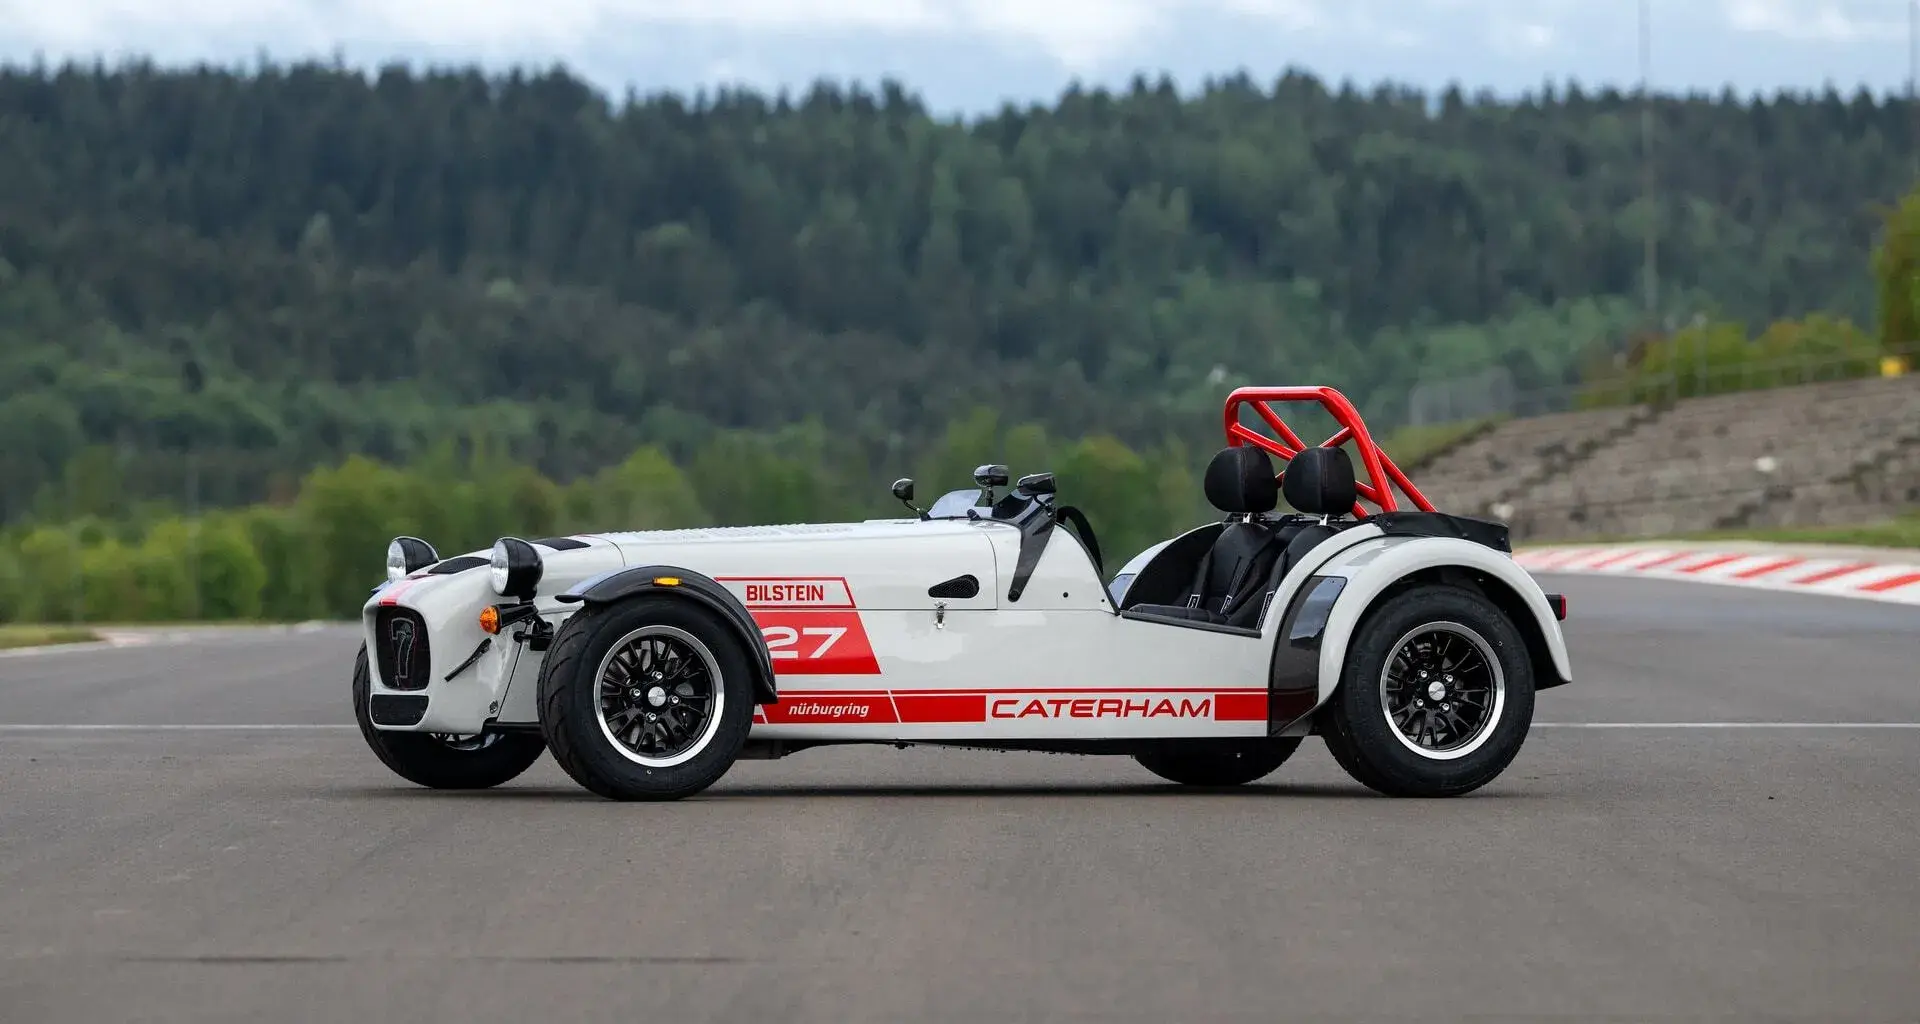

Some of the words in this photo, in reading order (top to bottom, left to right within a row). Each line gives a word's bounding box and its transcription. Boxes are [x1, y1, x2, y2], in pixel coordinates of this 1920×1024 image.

[746, 585, 824, 601] BILSTEIN
[390, 617, 415, 678] 7
[760, 626, 848, 659] 27
[788, 702, 869, 718] nürburgring
[991, 699, 1211, 718] CATERHAM
